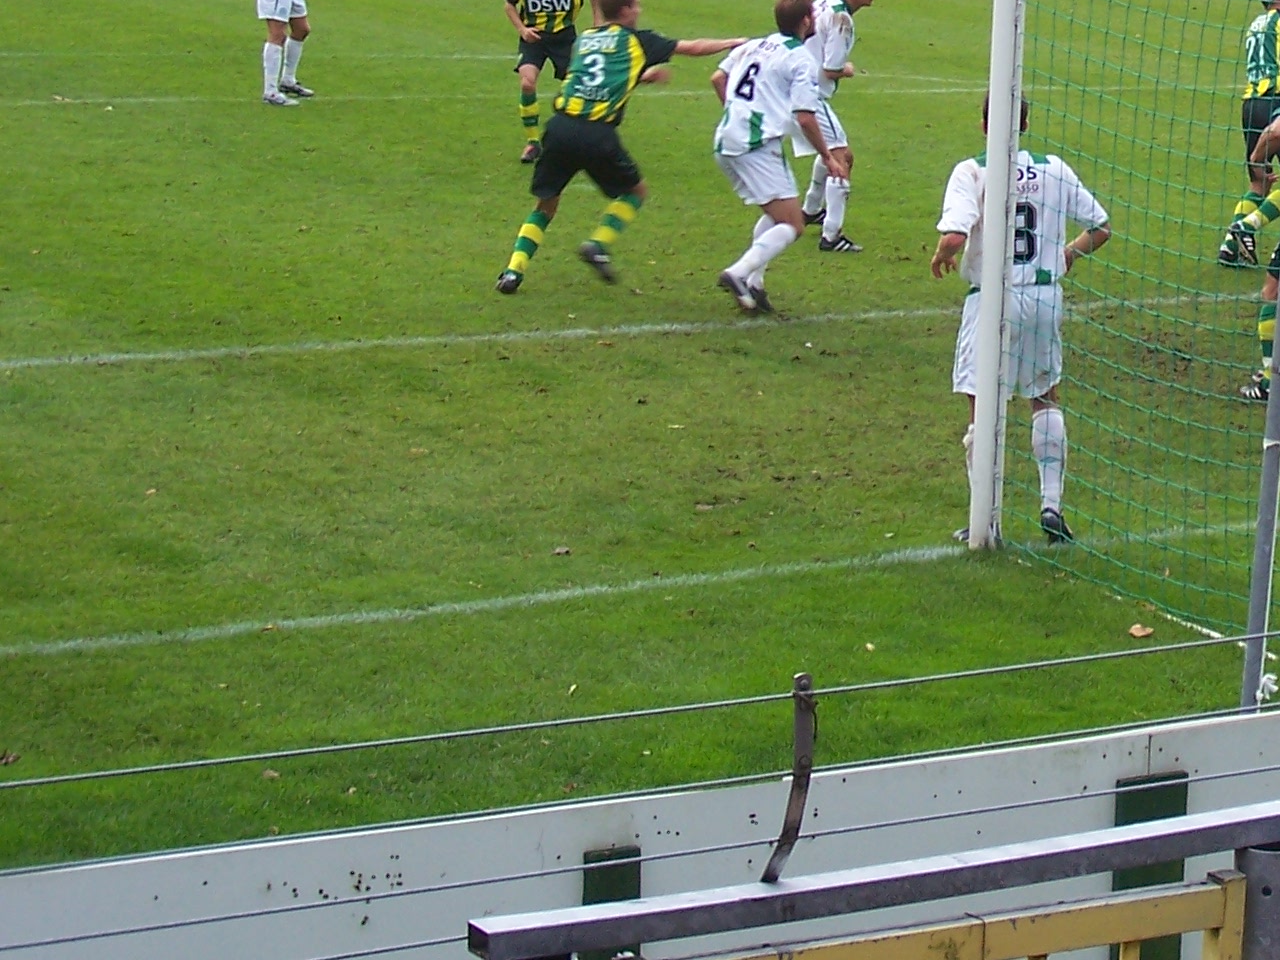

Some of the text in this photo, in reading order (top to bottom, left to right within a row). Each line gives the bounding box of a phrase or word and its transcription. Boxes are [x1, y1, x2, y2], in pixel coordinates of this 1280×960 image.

[579, 36, 619, 52] DSW
[582, 53, 606, 87] 3
[734, 62, 761, 101] 6
